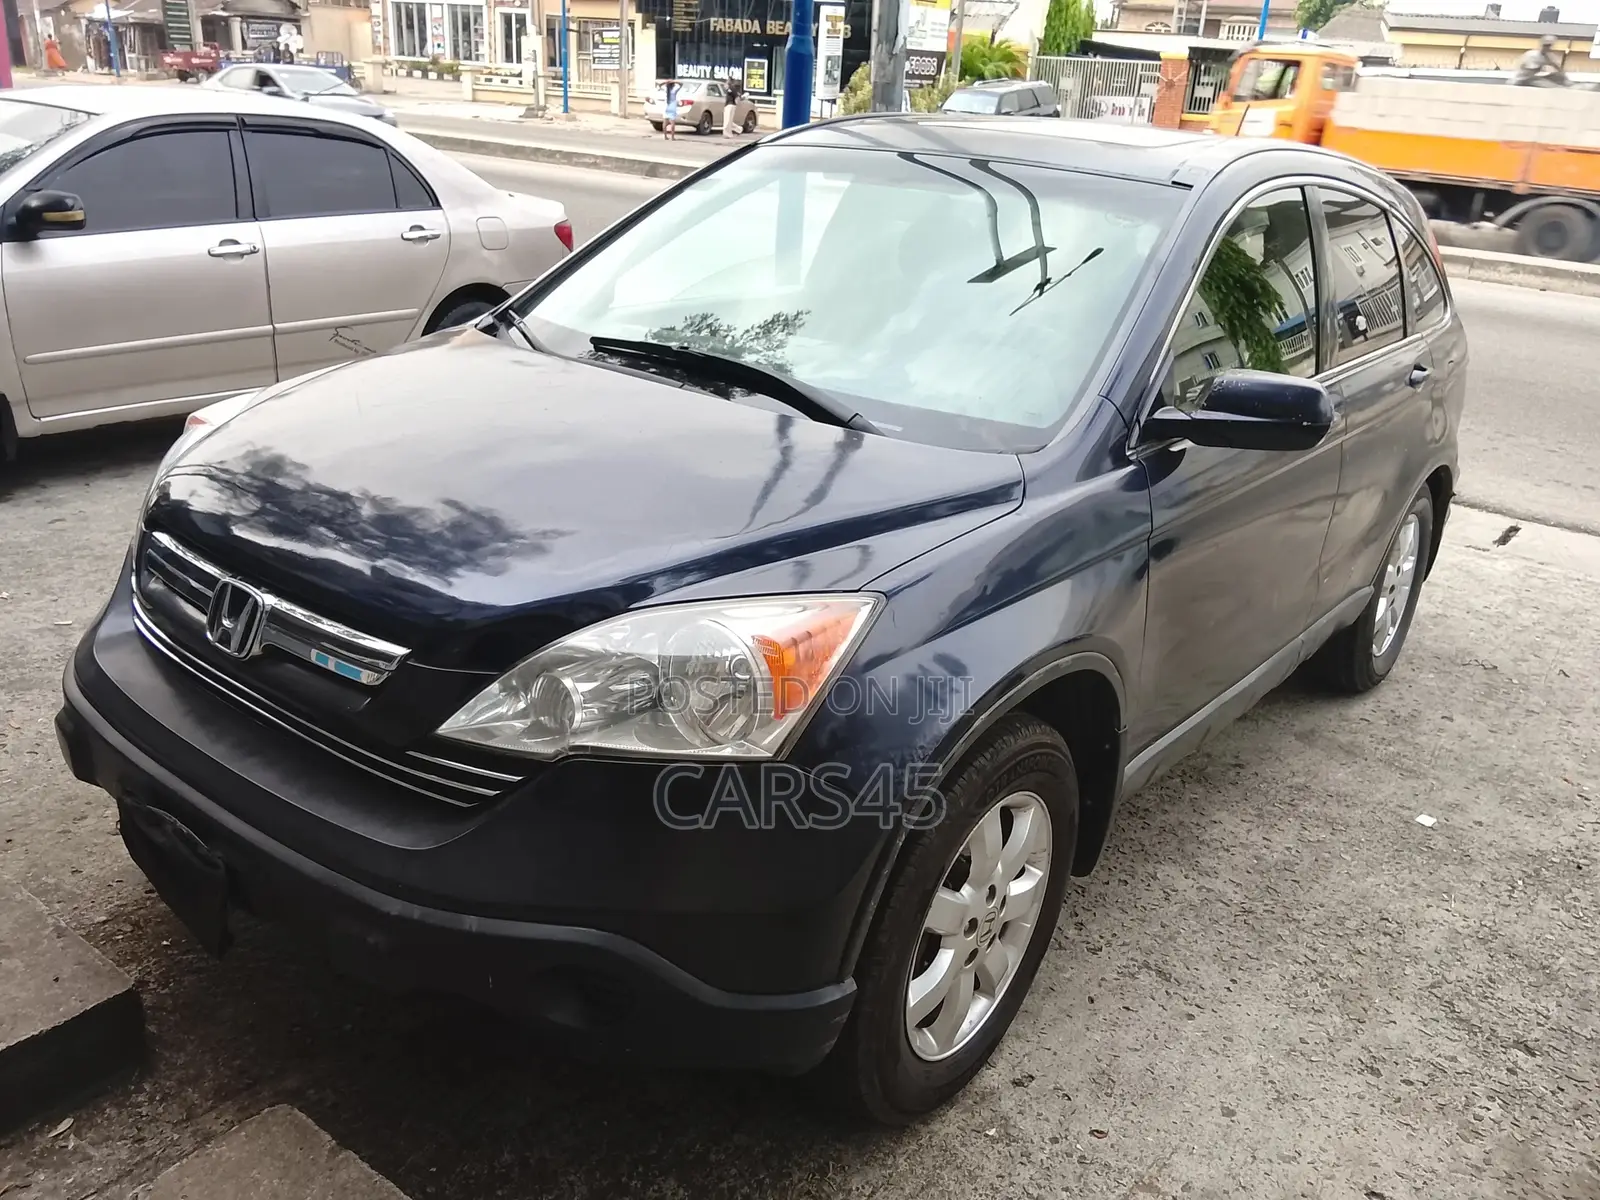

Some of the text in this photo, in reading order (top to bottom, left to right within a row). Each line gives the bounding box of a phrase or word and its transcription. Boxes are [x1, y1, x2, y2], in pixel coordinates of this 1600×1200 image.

[710, 17, 761, 35] FABADA
[766, 20, 818, 37] BEAY
[677, 64, 712, 79] BEAUTY
[714, 66, 742, 80] SALON
[908, 56, 938, 76] FOODS
